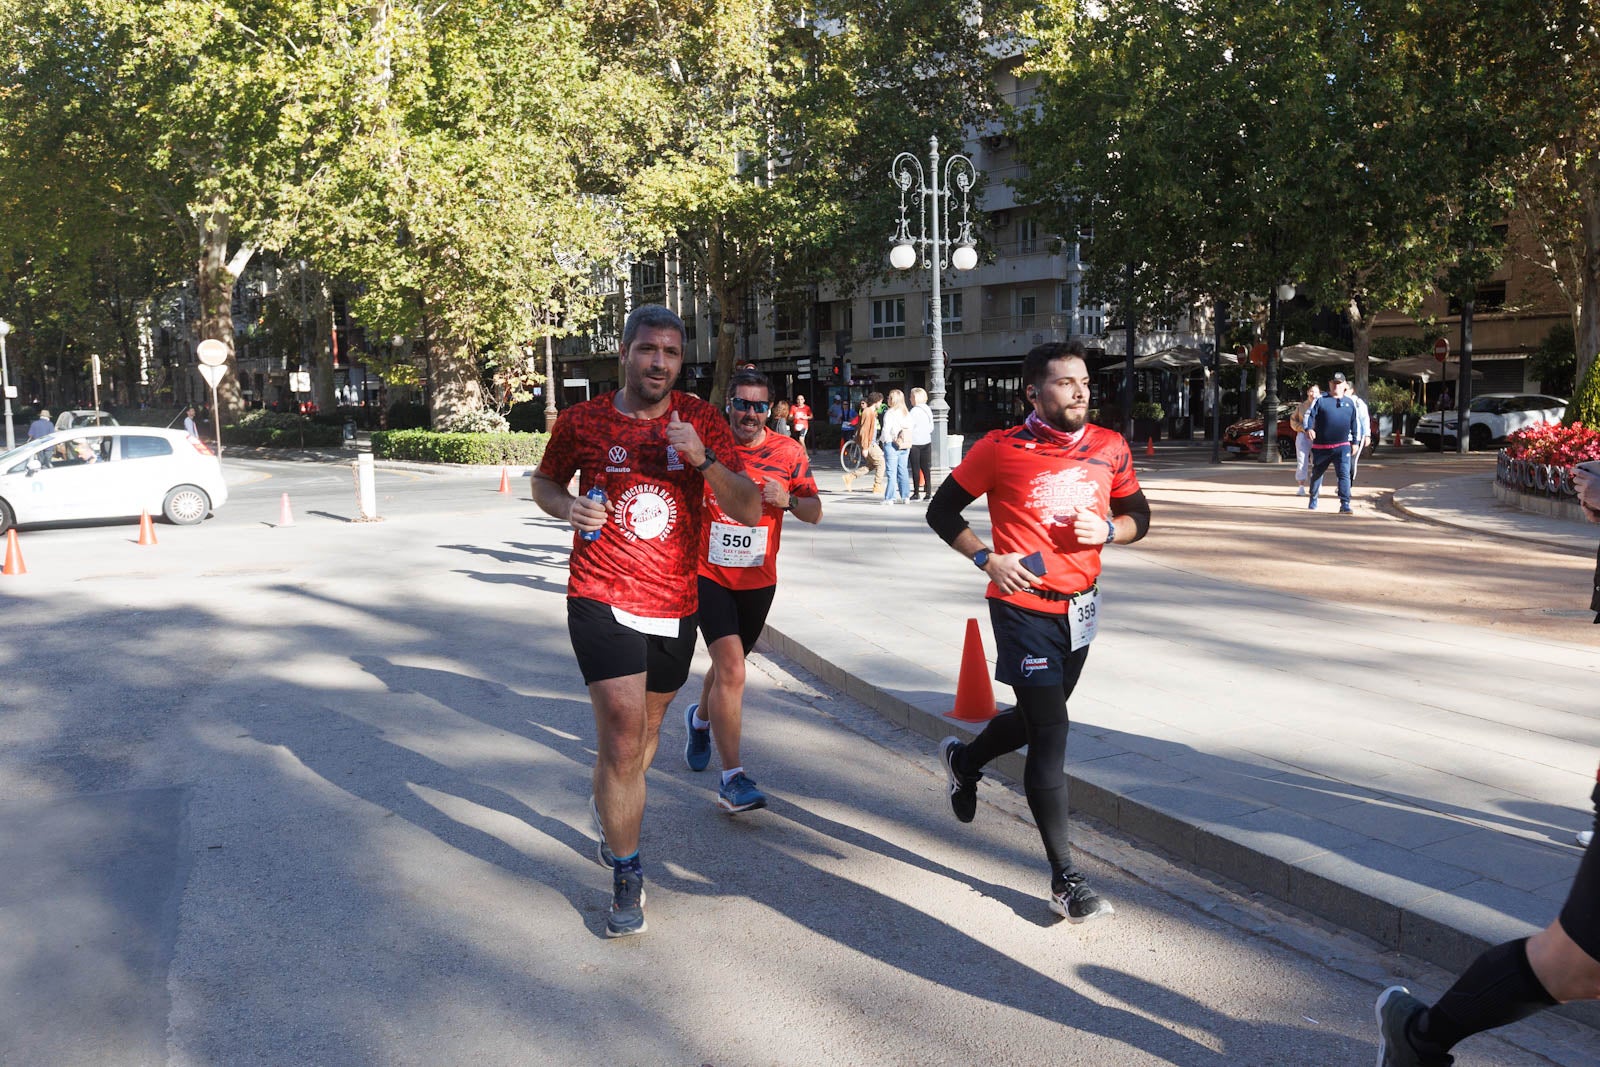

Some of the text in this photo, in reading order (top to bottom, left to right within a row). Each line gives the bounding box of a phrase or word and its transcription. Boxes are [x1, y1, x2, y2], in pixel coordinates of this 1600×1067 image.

[621, 483, 659, 501] NOCTURNA
[659, 489, 668, 499] DE
[665, 496, 677, 523] ATARFE
[722, 534, 752, 548] 550
[1077, 602, 1096, 623] 359
